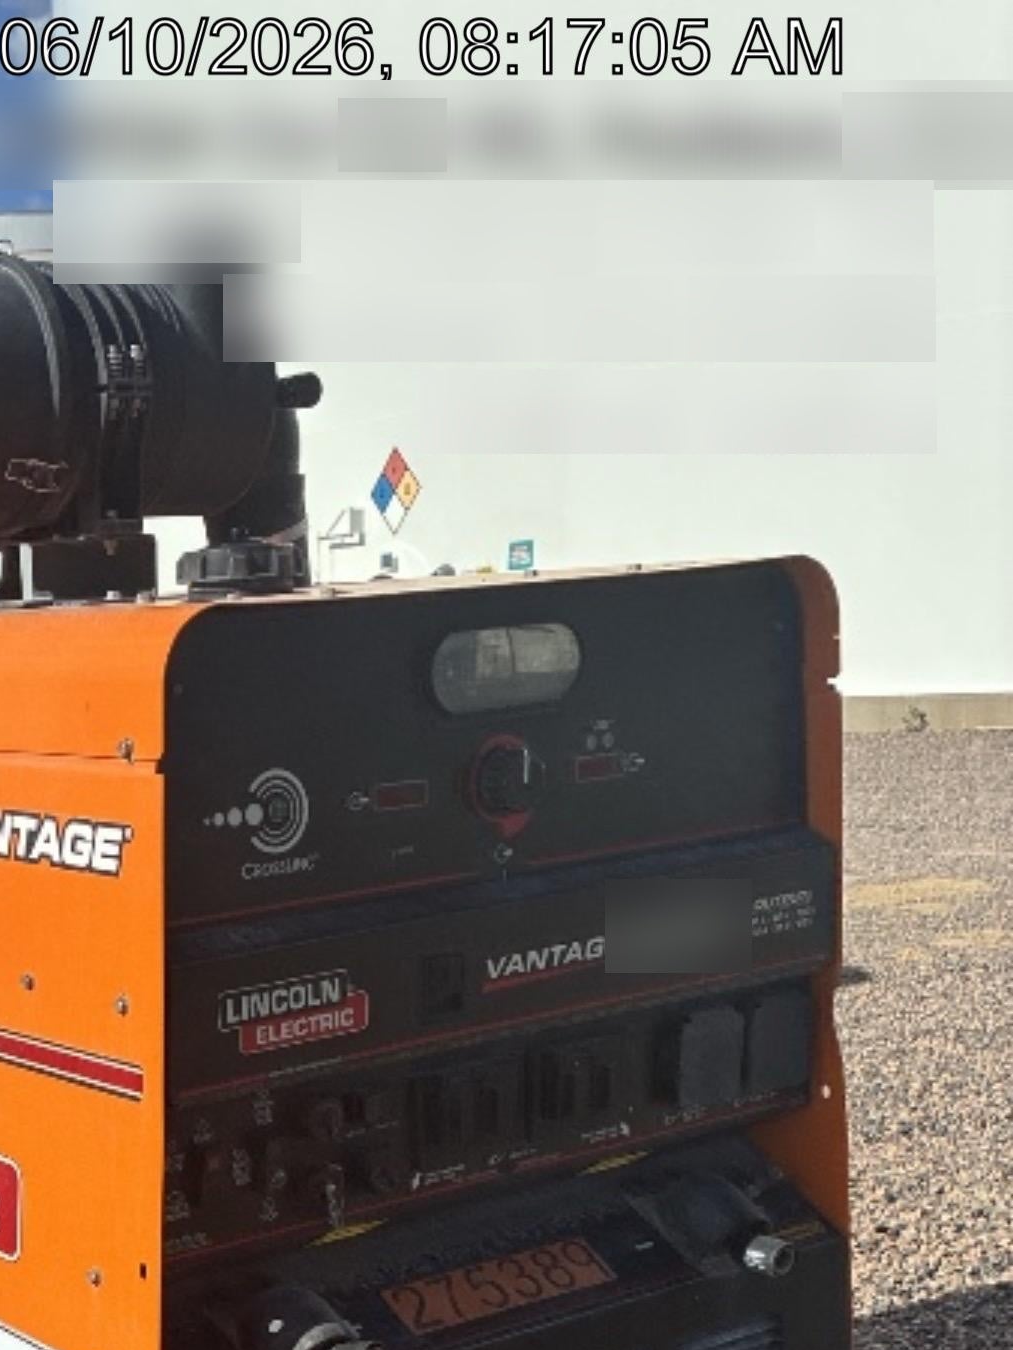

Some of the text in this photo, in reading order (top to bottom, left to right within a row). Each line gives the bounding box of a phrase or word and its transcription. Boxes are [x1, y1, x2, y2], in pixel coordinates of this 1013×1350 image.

[486, 935, 606, 979] VANTAG
[226, 977, 341, 1025] LINCOLN
[256, 1008, 356, 1045] ELECTRIC
[390, 1240, 611, 1329] 275389
